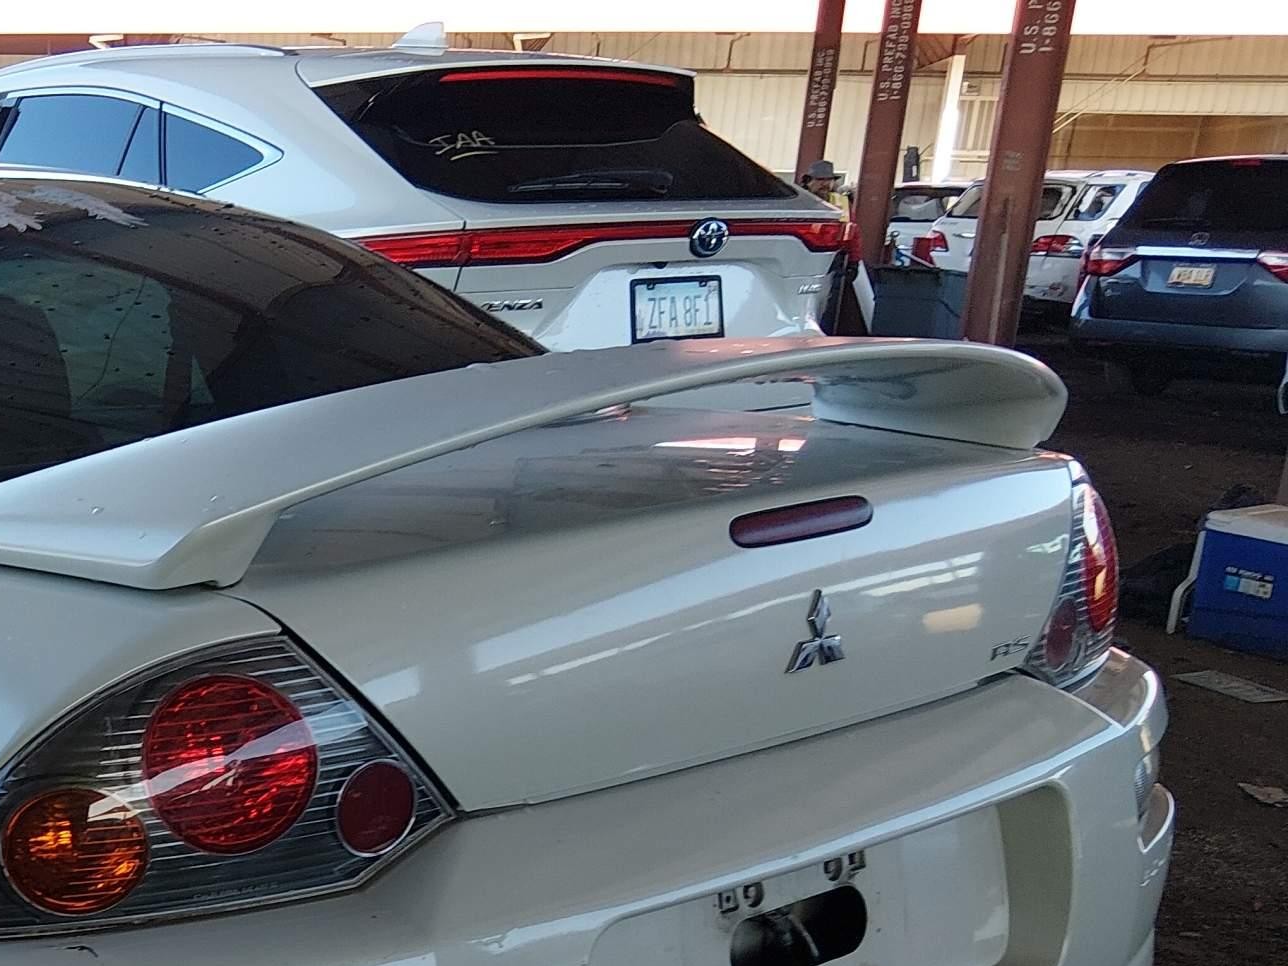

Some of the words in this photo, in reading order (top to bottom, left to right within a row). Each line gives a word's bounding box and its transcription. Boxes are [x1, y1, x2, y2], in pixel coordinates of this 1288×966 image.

[881, 24, 899, 72] PREFAB
[1018, 19, 1041, 54] U.S.
[808, 70, 823, 106] PREFAB
[877, 78, 891, 101] U.S.
[428, 130, 495, 156] IAA
